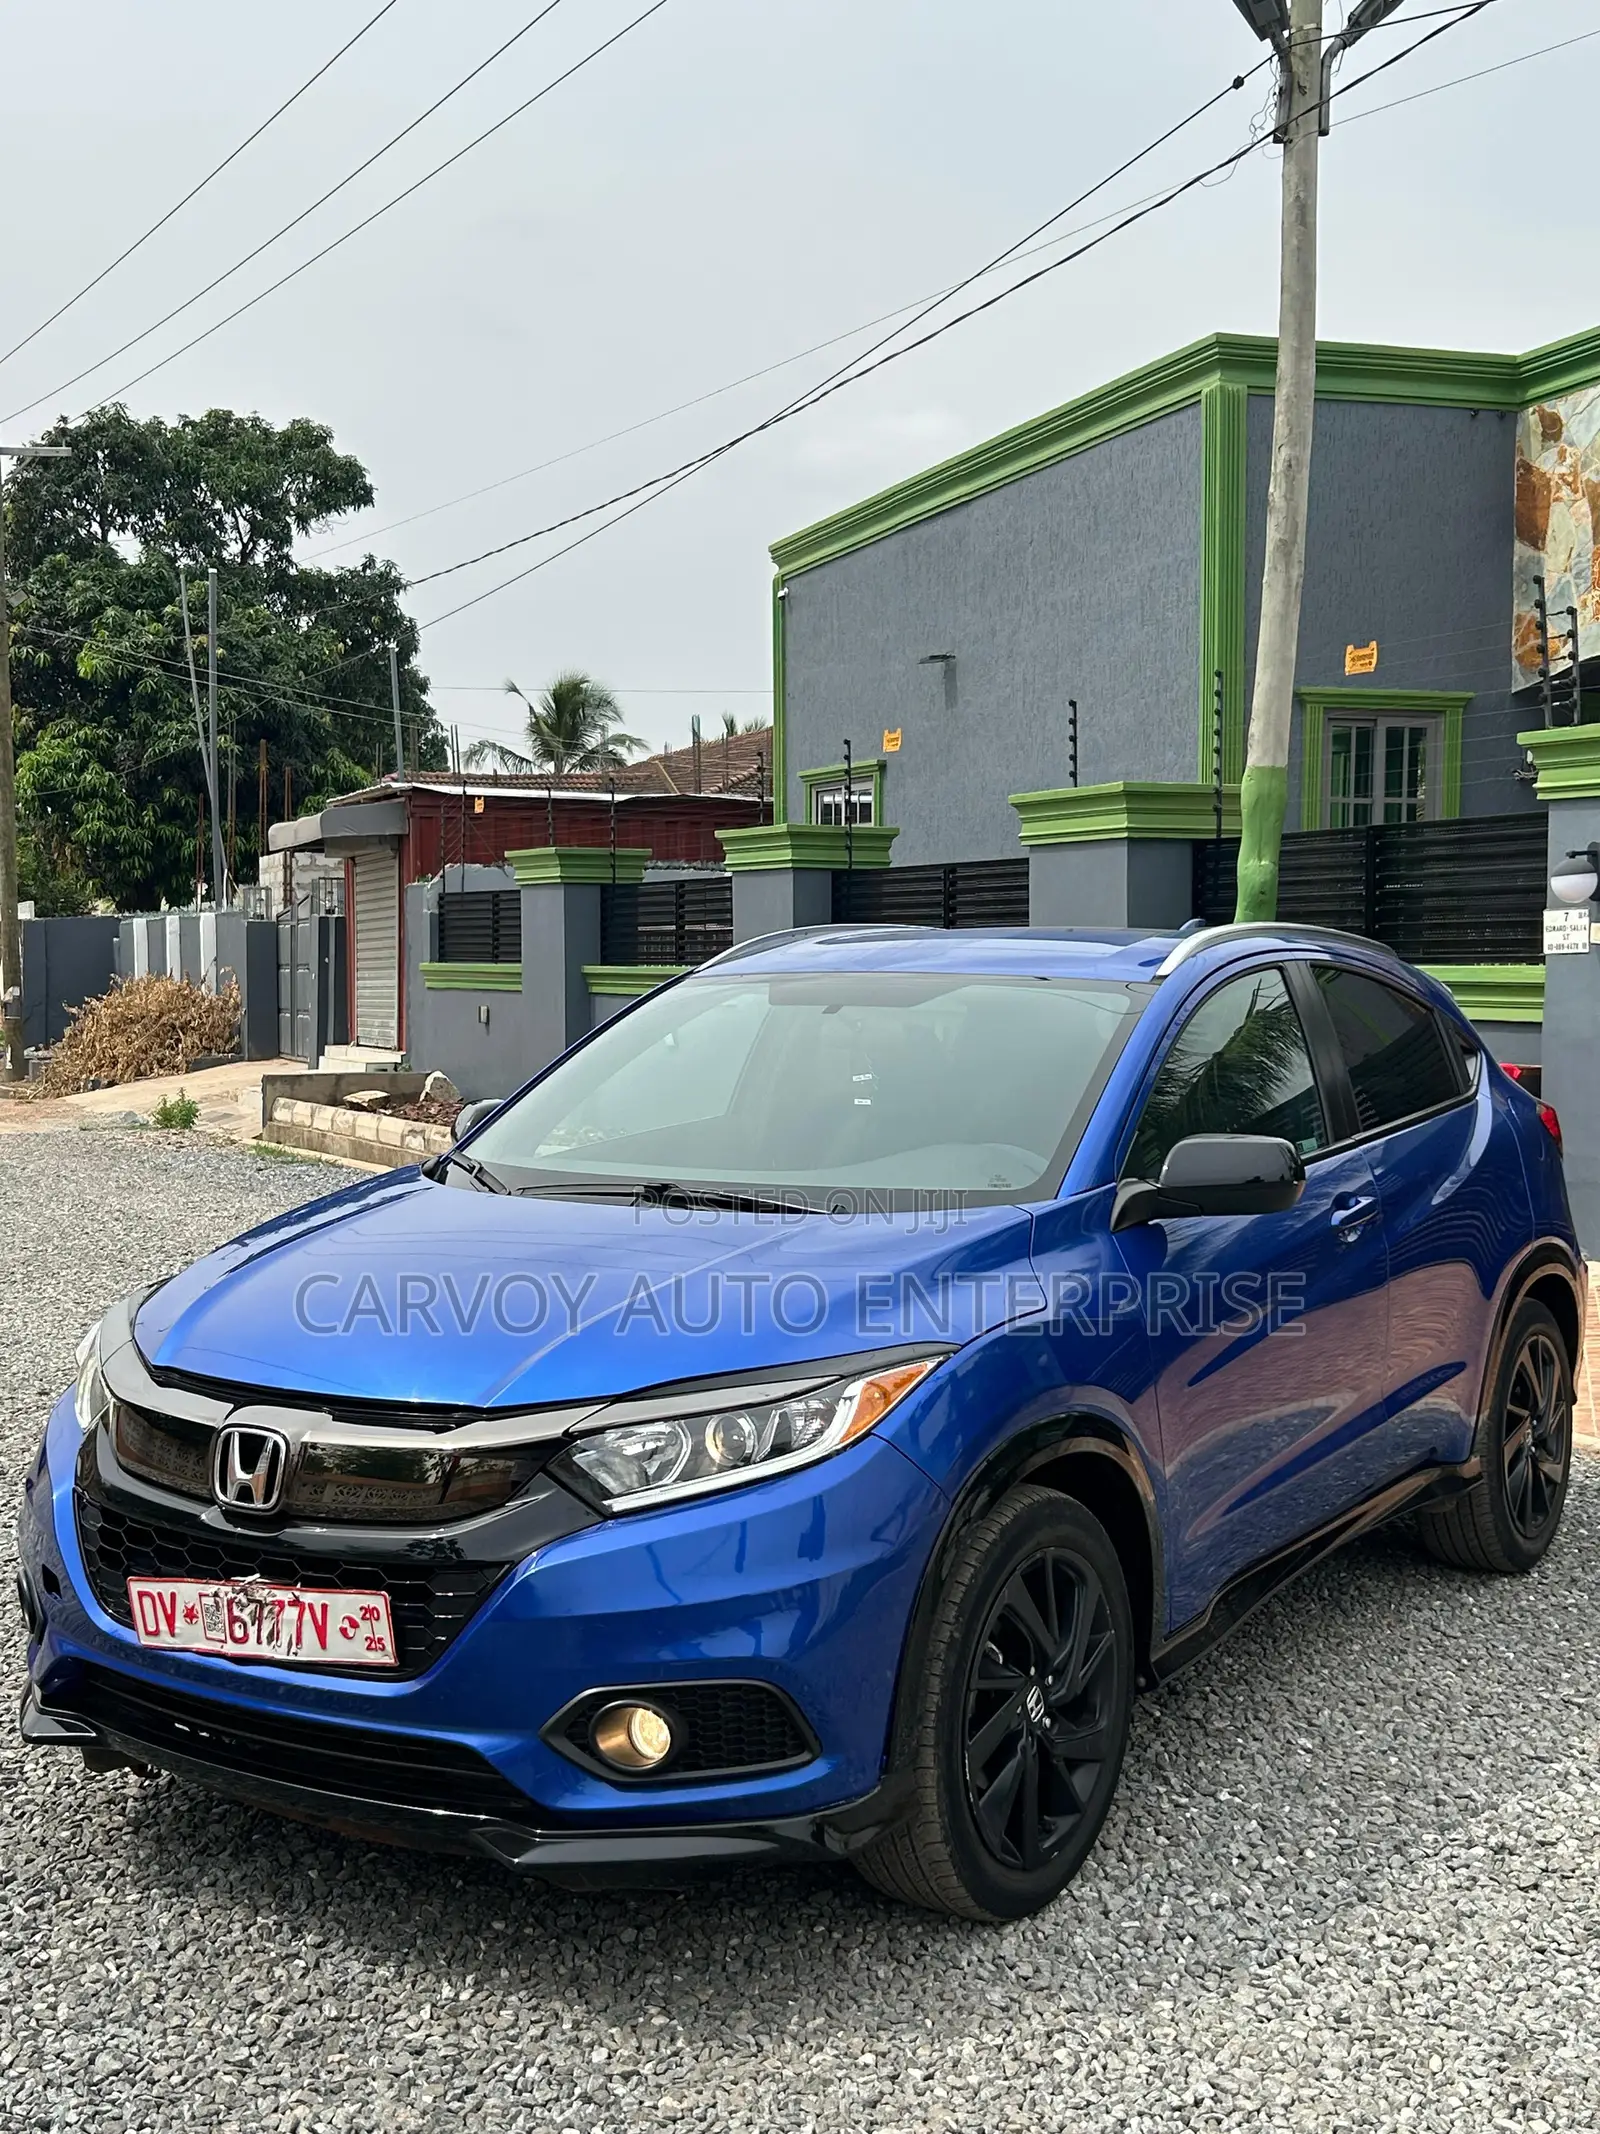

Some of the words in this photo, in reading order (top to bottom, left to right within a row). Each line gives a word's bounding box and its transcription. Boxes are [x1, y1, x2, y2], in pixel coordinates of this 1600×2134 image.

[1564, 912, 1569, 922] 7
[137, 1590, 177, 1638] DV
[359, 1604, 380, 1621] 20
[364, 1635, 386, 1652] 25
